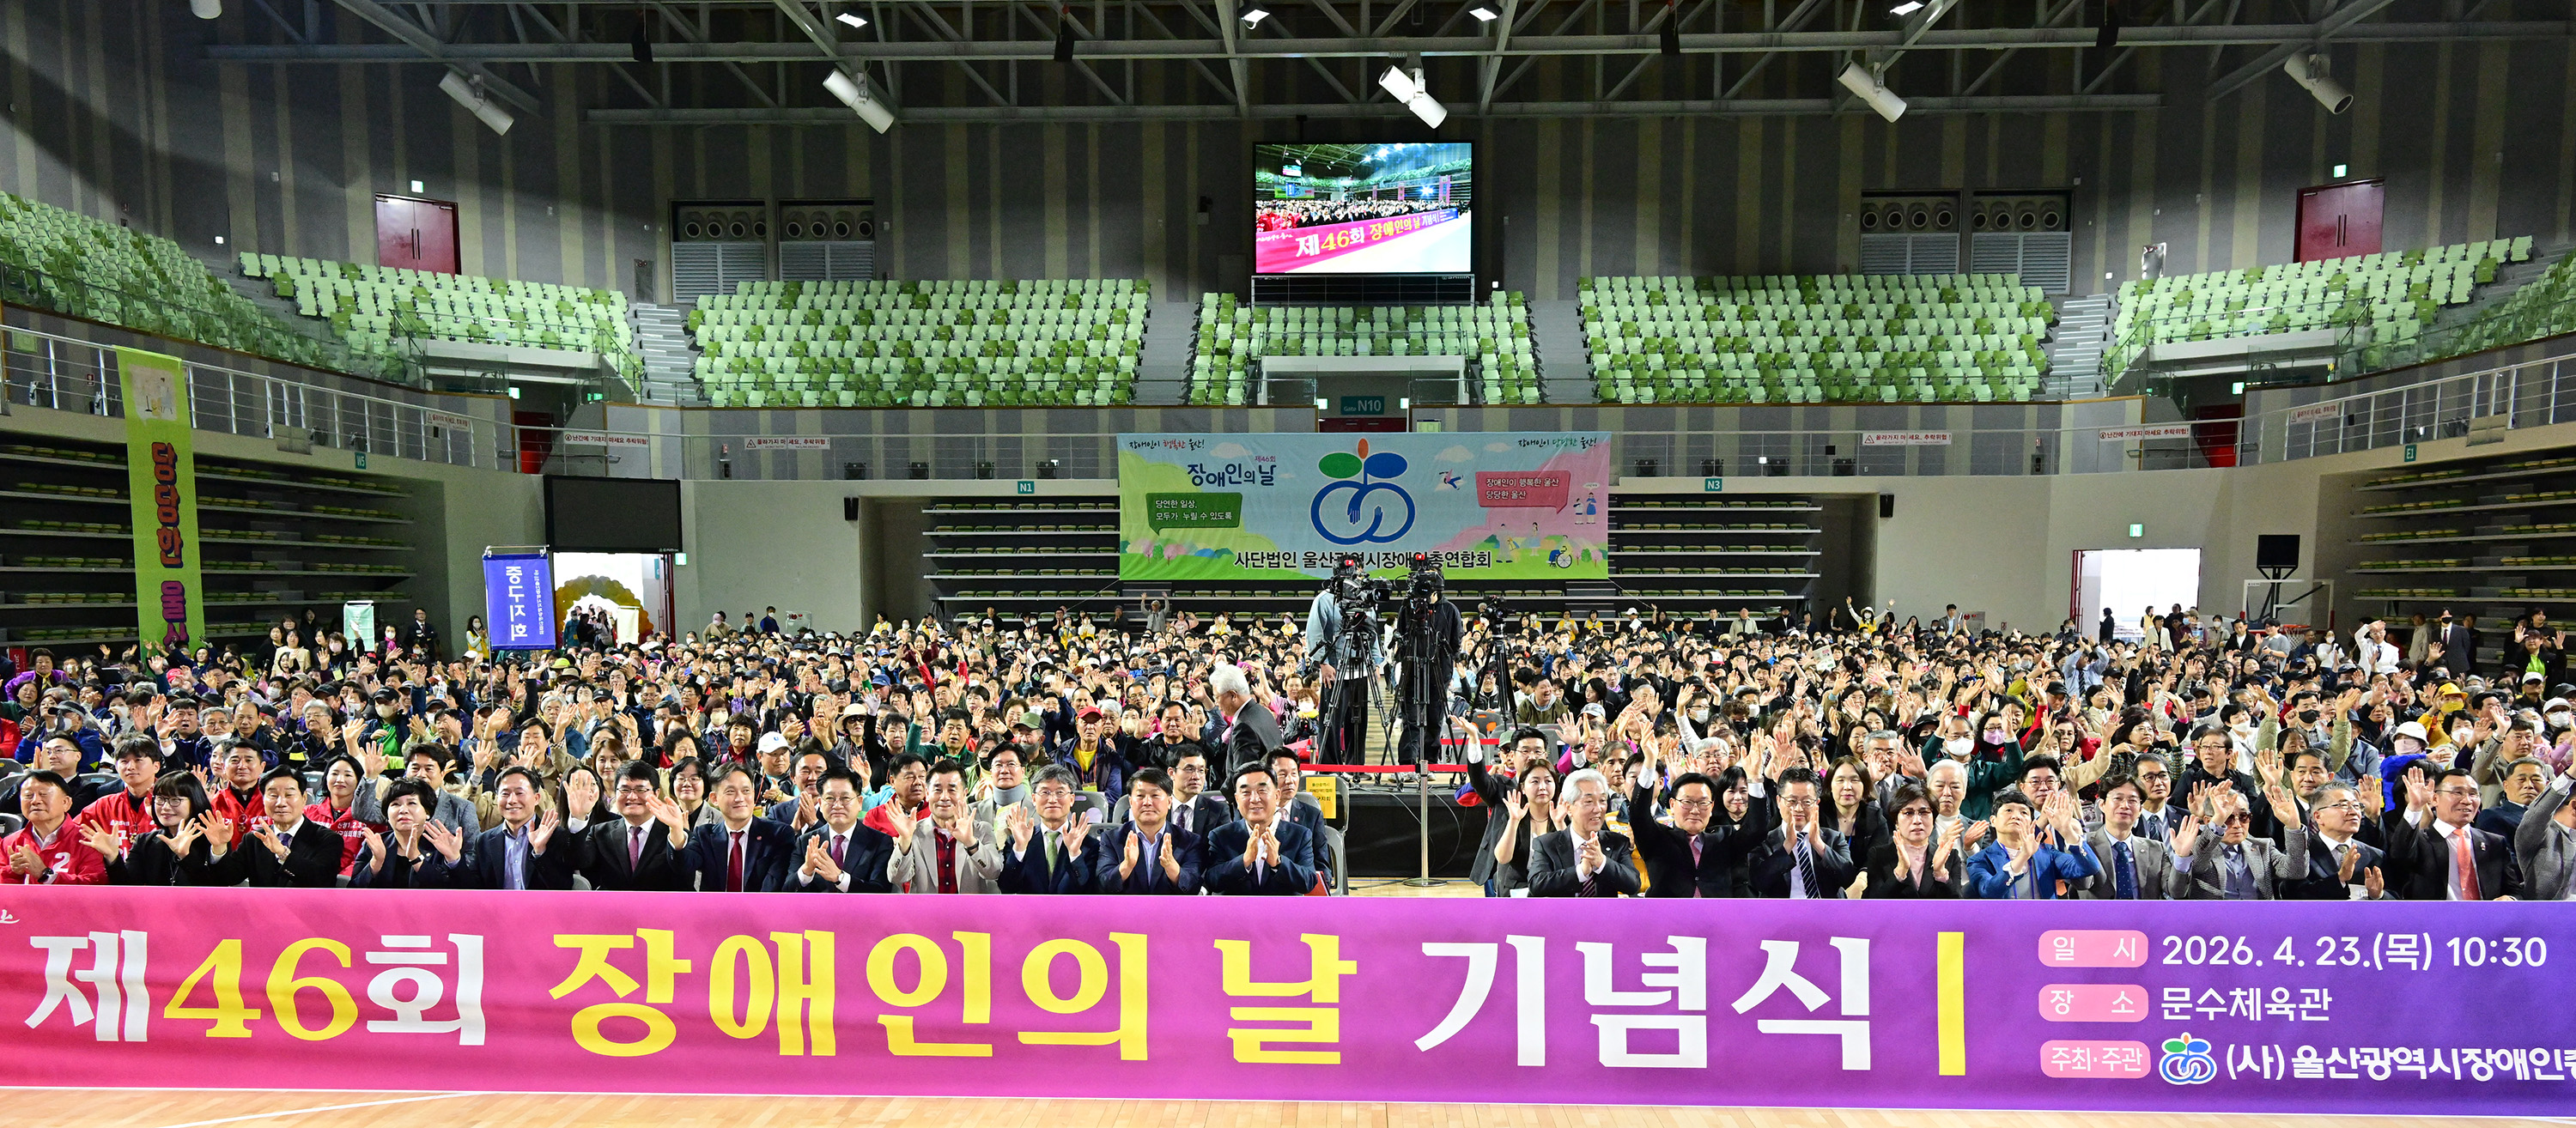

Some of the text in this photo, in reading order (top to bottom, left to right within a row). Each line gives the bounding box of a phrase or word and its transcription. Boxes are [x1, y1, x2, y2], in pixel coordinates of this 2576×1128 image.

[1296, 227, 1364, 258] 제46회
[1358, 399, 1382, 412] N10
[1129, 440, 1161, 449] 장애인이
[1518, 439, 1550, 448] 장애인이
[1188, 463, 1277, 487] 장애인의 날
[1486, 478, 1559, 487] 장애인이 행복한 울산
[1020, 482, 1032, 492] N1
[1707, 480, 1720, 489] N3
[1485, 490, 1527, 500] 당당한 울산
[151, 442, 184, 569] 당당한
[1210, 512, 1232, 520] 있도록
[1235, 551, 1297, 568] 사단법인
[53, 852, 70, 873] 2
[2162, 935, 2263, 967] 2026.
[2274, 936, 2305, 967] 4.
[2446, 937, 2548, 967] 10:30
[25, 927, 1870, 1070] 제46회 장애인의 날 기념식
[2161, 986, 2333, 1022] 문수체육관
